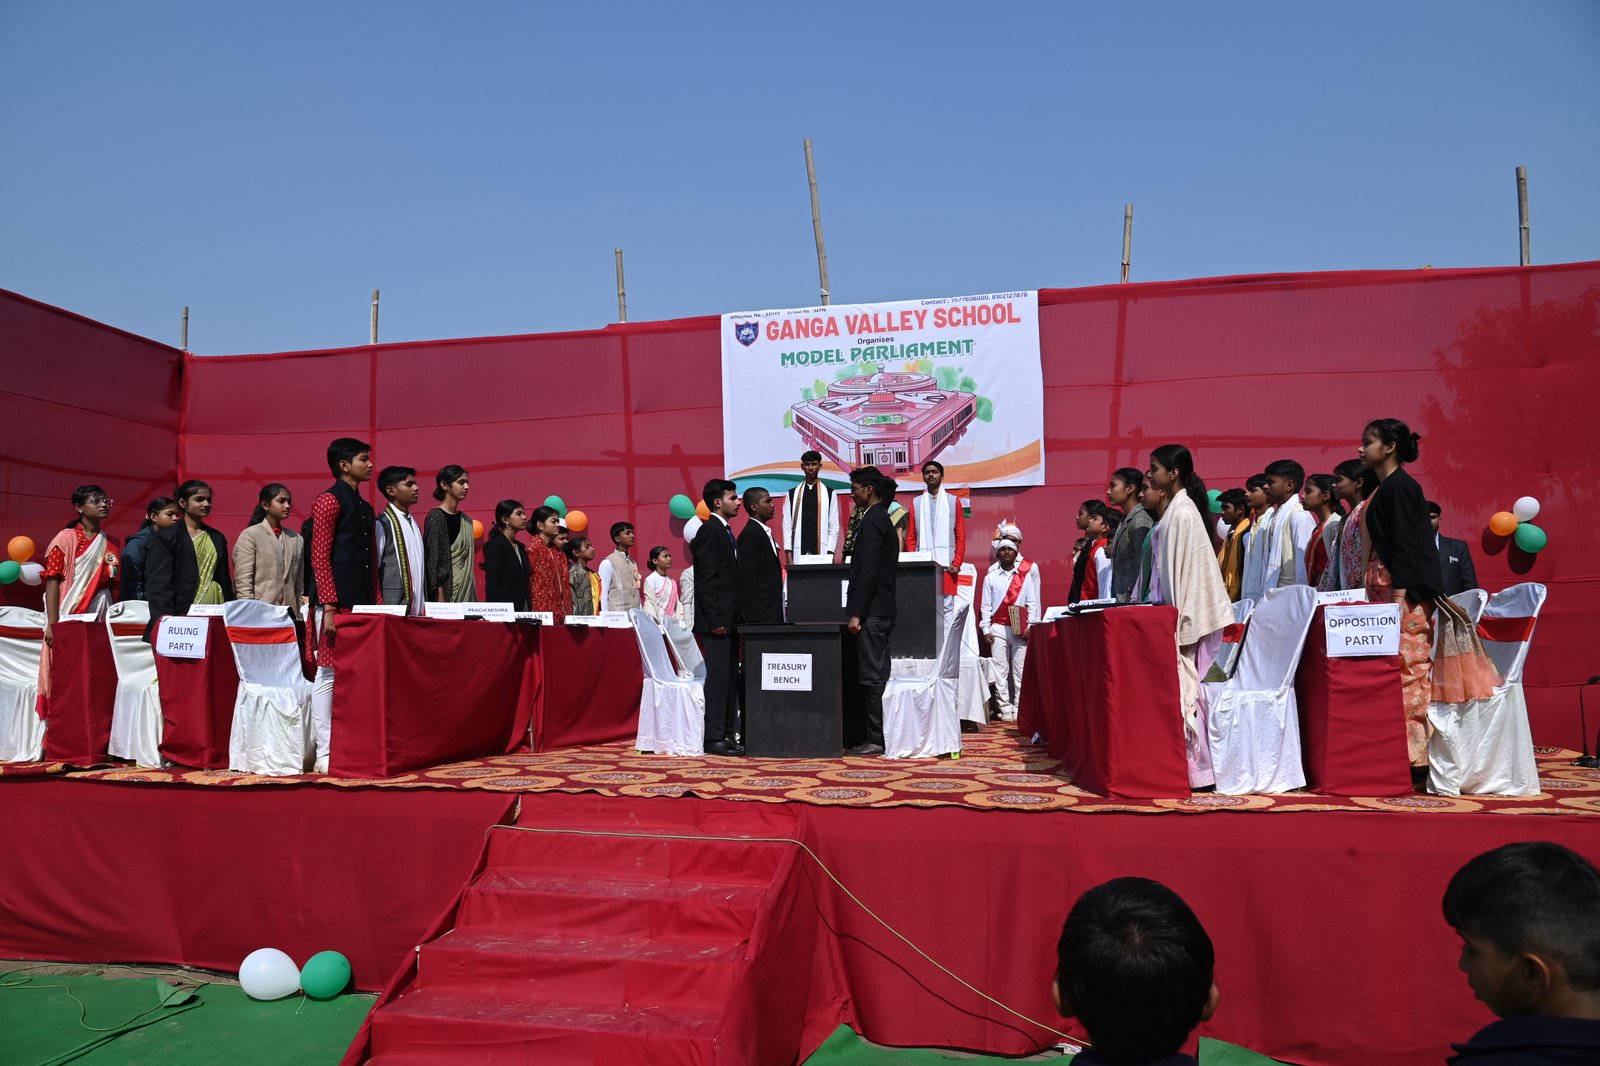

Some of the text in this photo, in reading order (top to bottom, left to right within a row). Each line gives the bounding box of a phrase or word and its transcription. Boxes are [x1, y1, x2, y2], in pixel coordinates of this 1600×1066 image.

[766, 302, 1020, 341] GANGA VALLEY SCHOOL
[858, 336, 894, 345] Organises
[780, 339, 974, 367] MODEL PARLIAMENT
[1329, 616, 1396, 628] OPPOSITION
[168, 626, 199, 636] RULING
[168, 642, 194, 650] PARTY
[1345, 635, 1384, 646] PARTY
